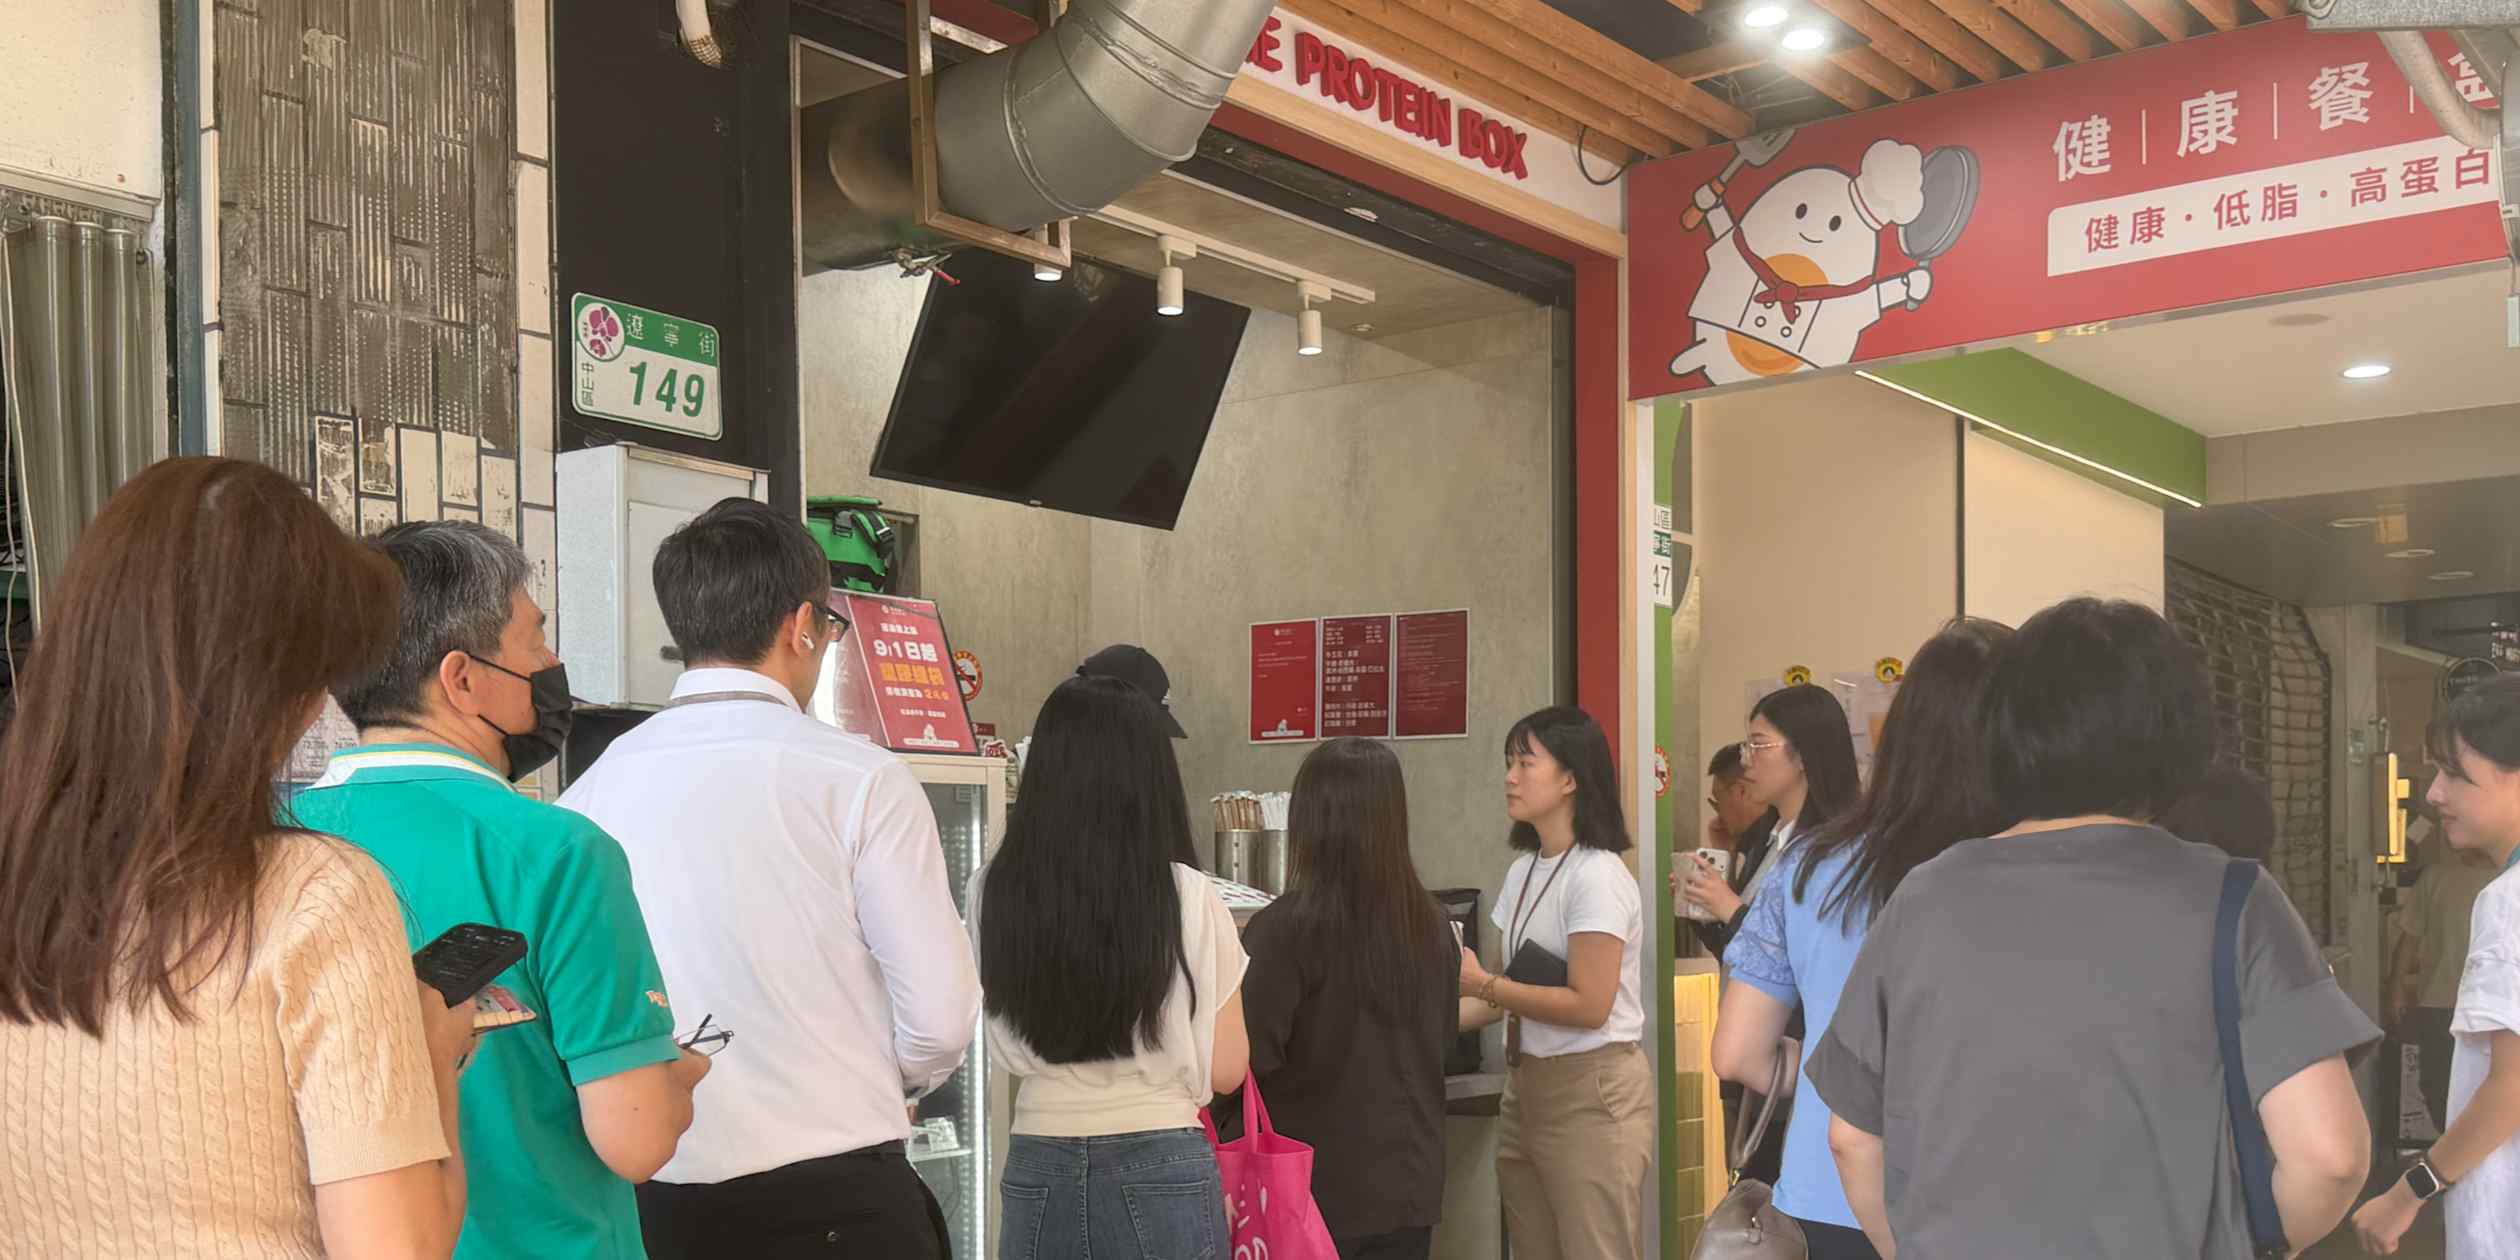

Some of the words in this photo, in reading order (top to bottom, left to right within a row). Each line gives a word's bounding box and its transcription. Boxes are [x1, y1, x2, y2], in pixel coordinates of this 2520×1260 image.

[1294, 31, 1452, 147] PROTEIN
[1458, 108, 1528, 180] BOX
[581, 362, 595, 407] 中山區
[629, 361, 705, 418] 149
